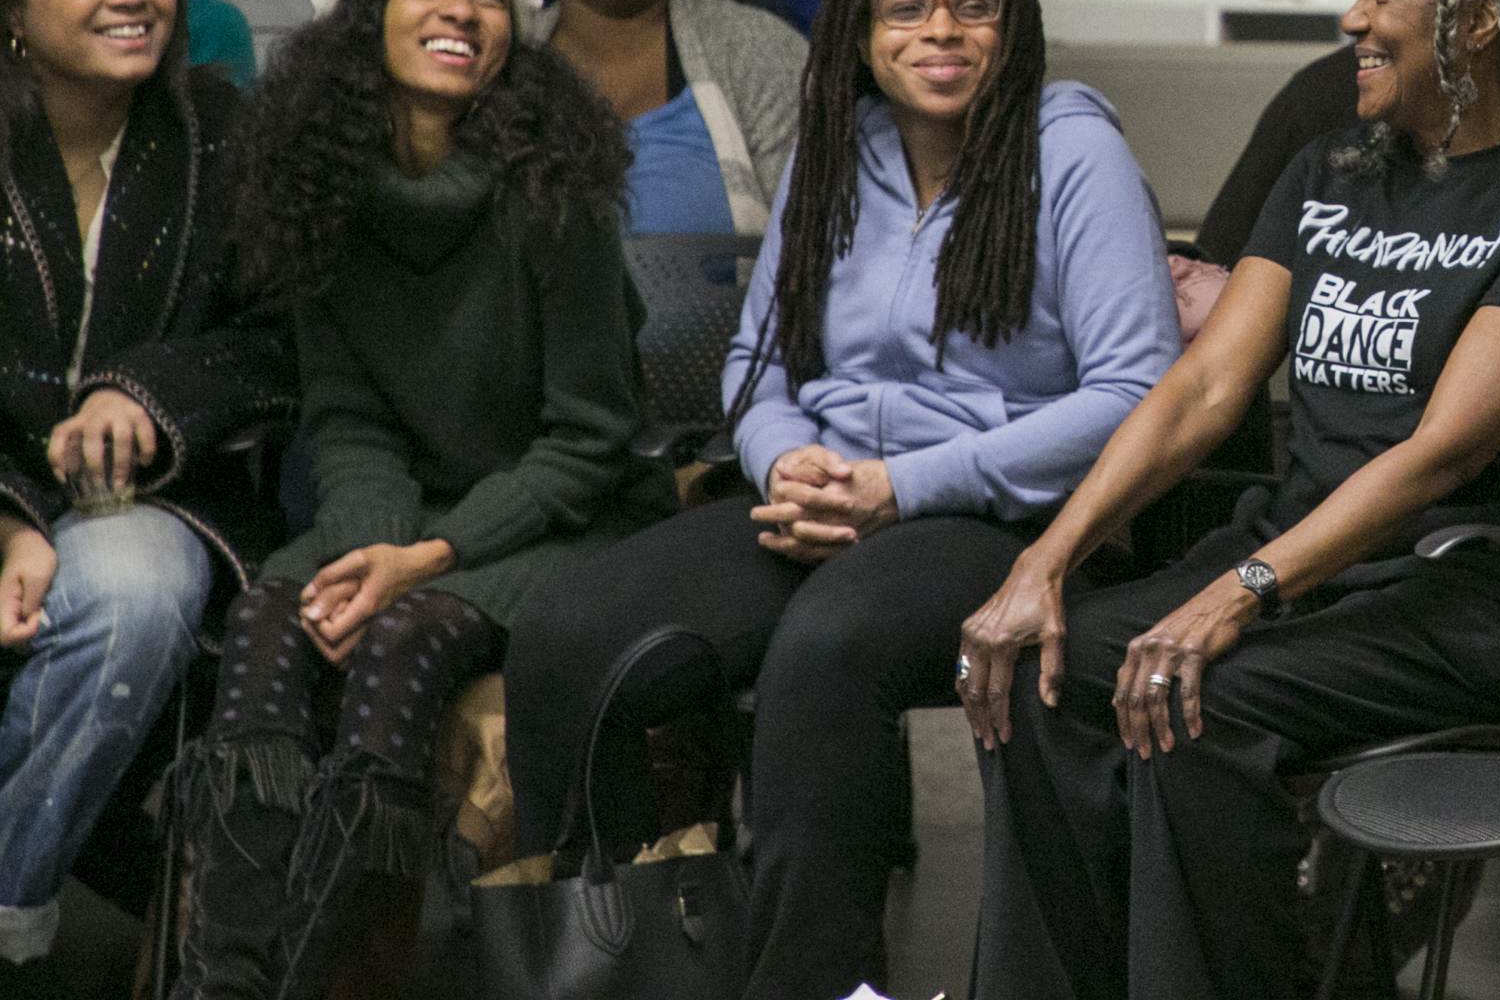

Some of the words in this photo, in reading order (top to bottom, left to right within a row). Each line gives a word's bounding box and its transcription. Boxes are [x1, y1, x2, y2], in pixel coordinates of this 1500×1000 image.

[1310, 272, 1432, 318] BLACK
[1299, 305, 1417, 369] DANCE
[1295, 356, 1416, 395] MATTERS.
